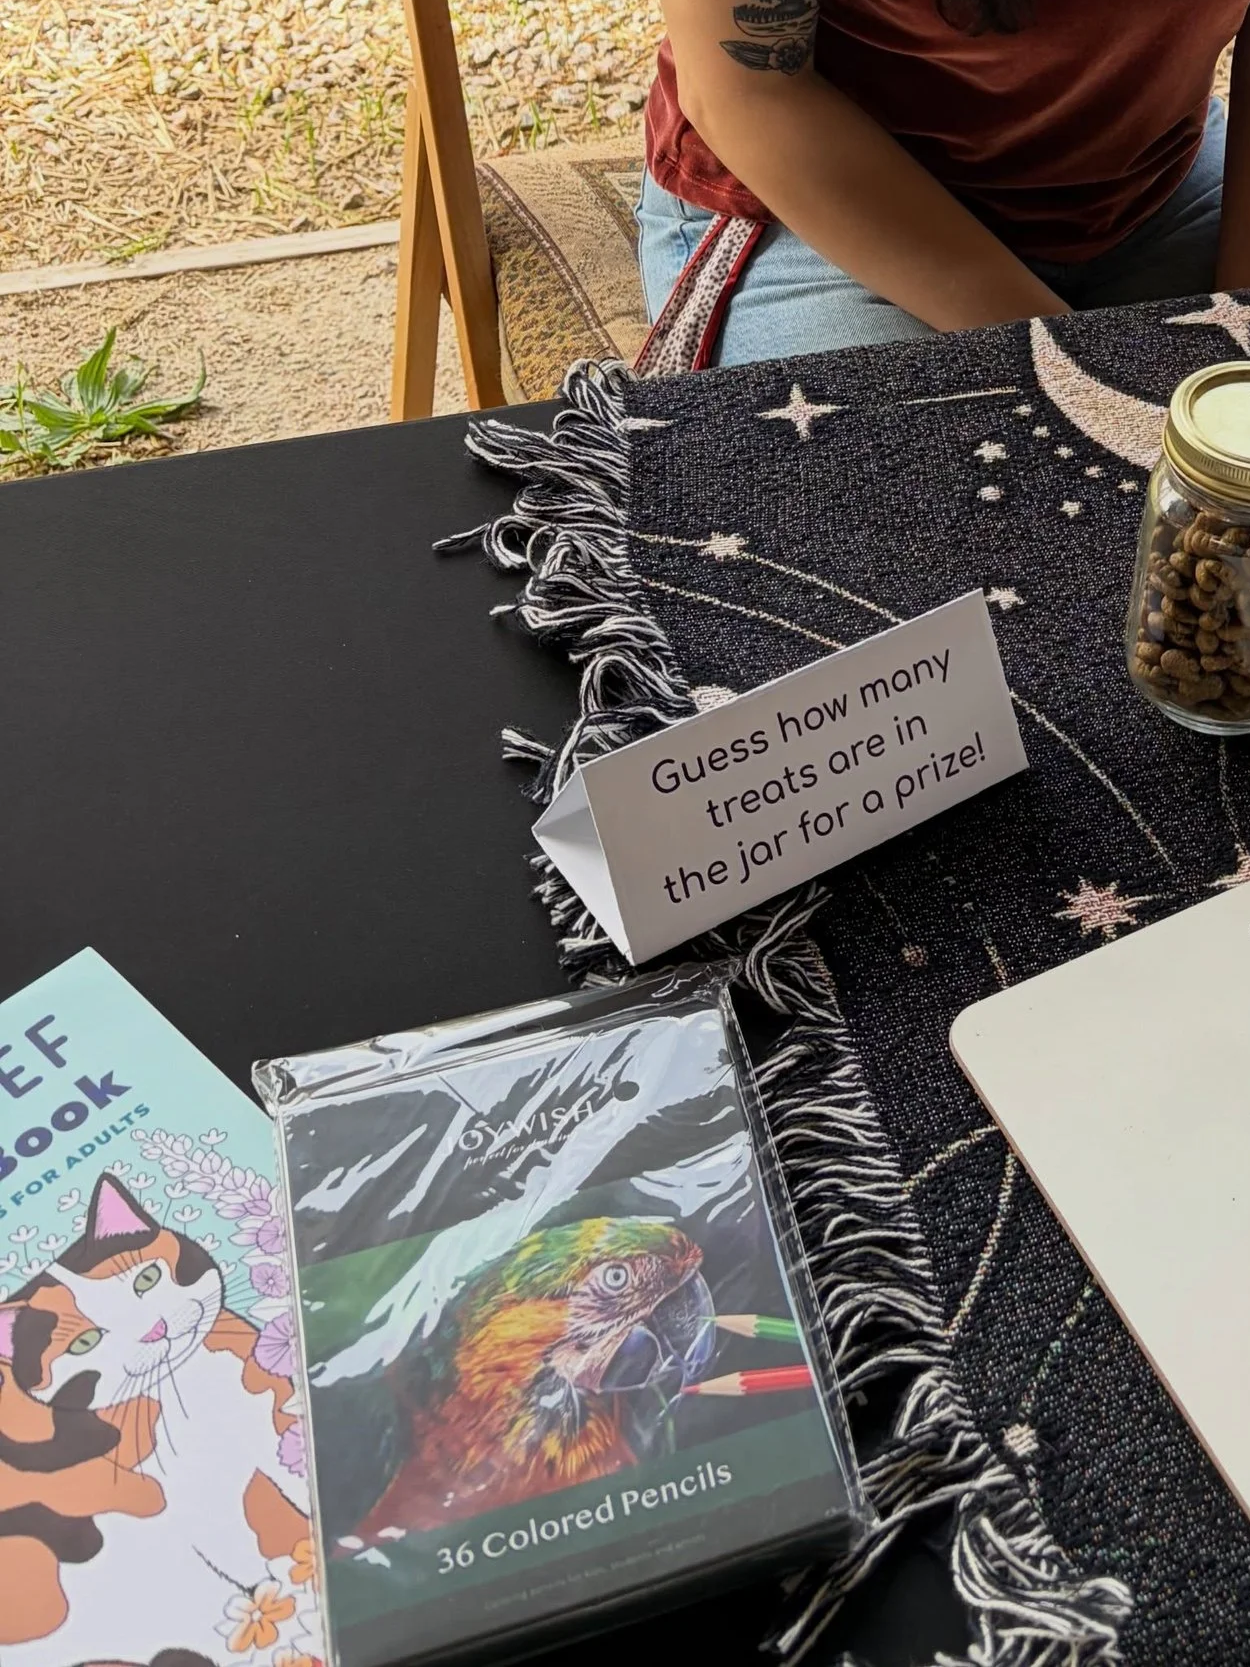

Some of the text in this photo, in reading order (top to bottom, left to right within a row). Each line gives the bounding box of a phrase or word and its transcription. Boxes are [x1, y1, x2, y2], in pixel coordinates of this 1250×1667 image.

[651, 648, 951, 794] Guess how many
[706, 715, 928, 828] treats are in
[663, 732, 987, 904] the jar for a prize!
[10, 1102, 151, 1207] FOR ADULTS
[436, 1539, 475, 1575] 36
[482, 1495, 617, 1561] Colored
[621, 1461, 733, 1518] Pencils
